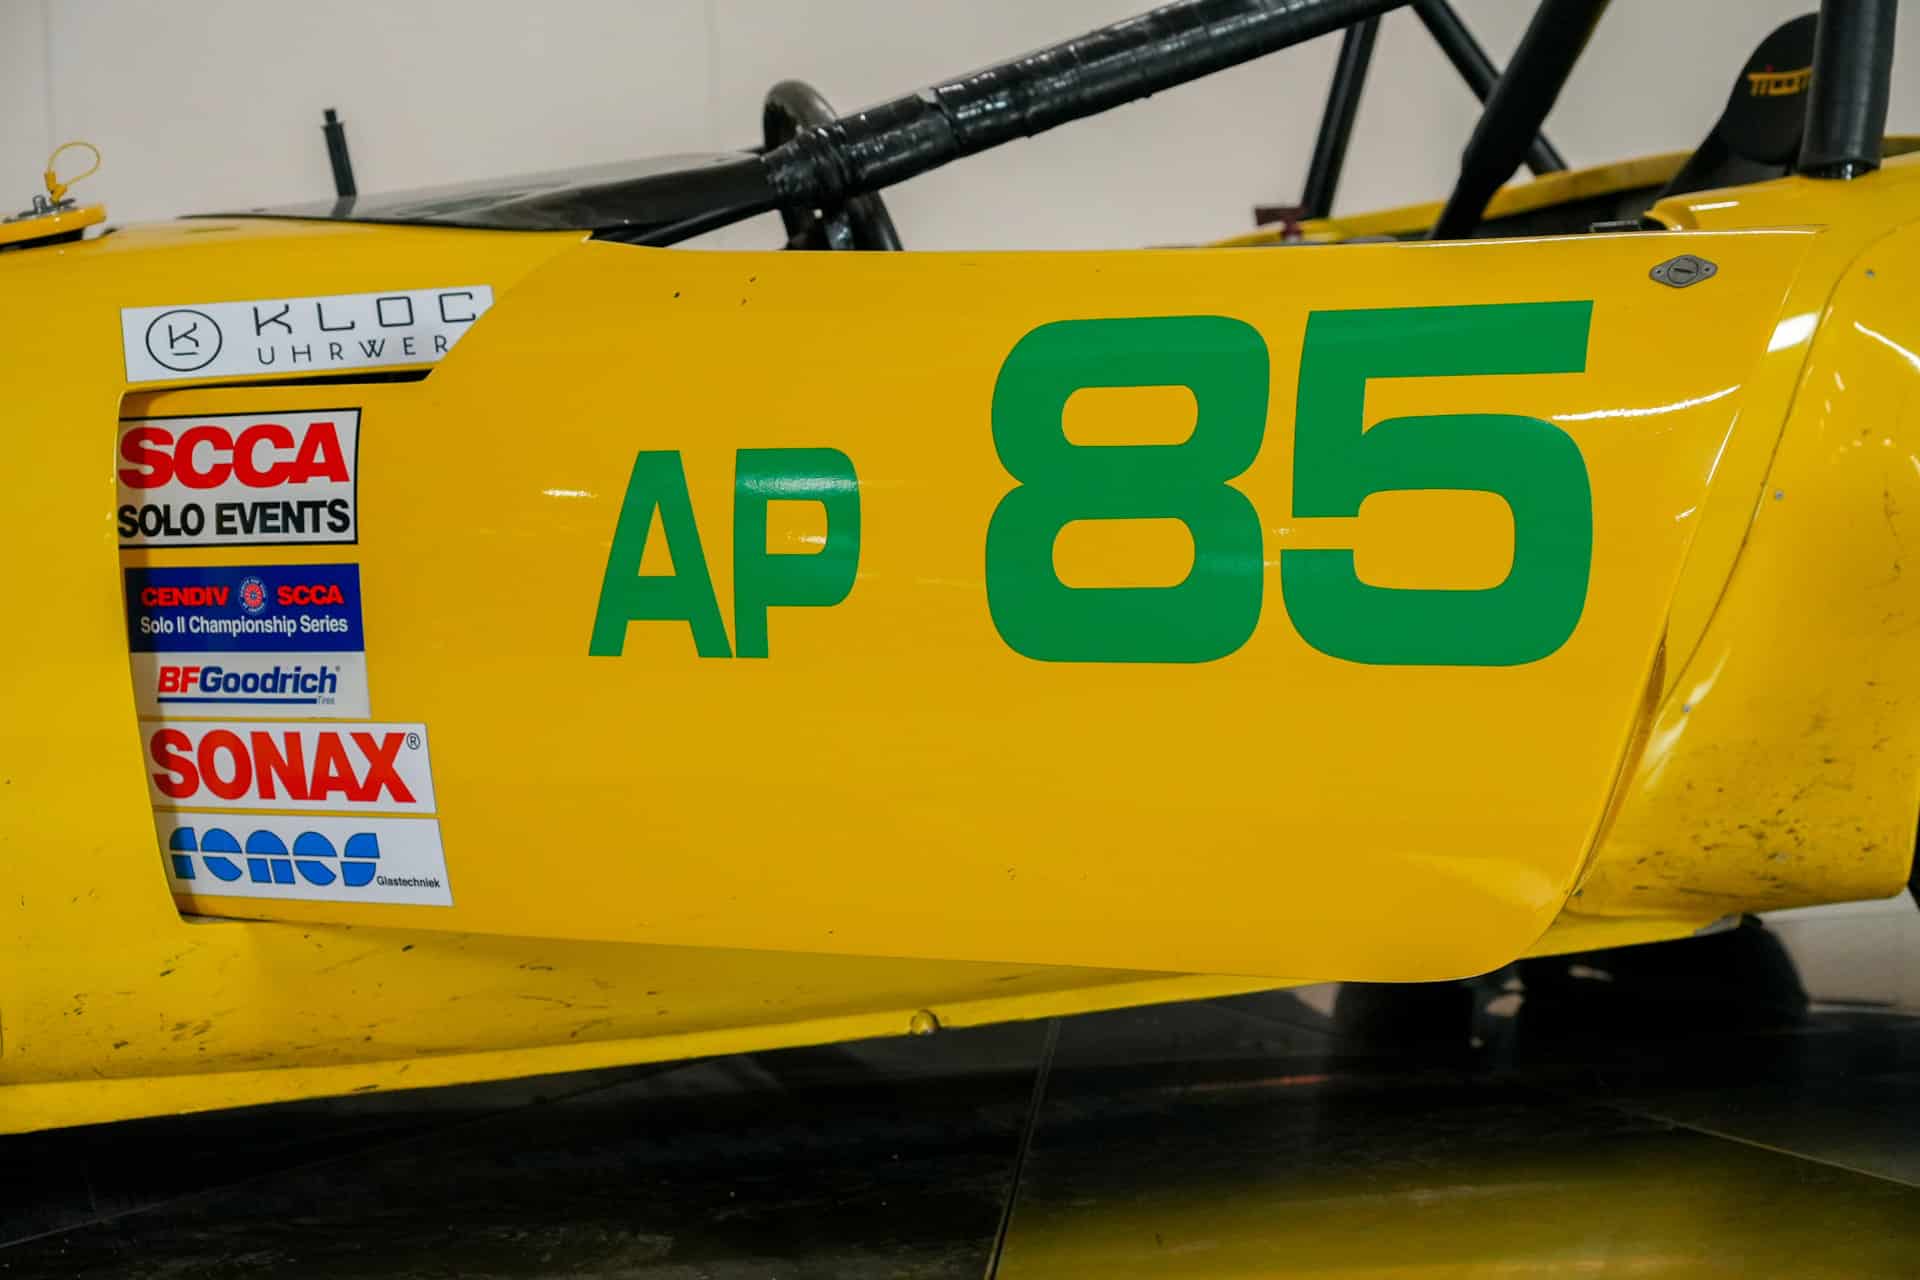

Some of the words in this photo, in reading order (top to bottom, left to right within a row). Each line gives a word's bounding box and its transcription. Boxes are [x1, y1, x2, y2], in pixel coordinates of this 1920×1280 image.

[118, 422, 350, 489] SCCA
[985, 300, 1594, 667] 85
[118, 504, 205, 537] SOLO
[216, 499, 351, 535] EVENTS
[588, 447, 861, 659] AP
[141, 586, 229, 606] CENDIV
[277, 585, 344, 605] SCCA
[140, 617, 173, 635] Solo
[188, 616, 297, 637] Championship
[300, 615, 348, 633] Series
[157, 666, 338, 694] BFGoodrich
[376, 875, 441, 889] Glastechniek
